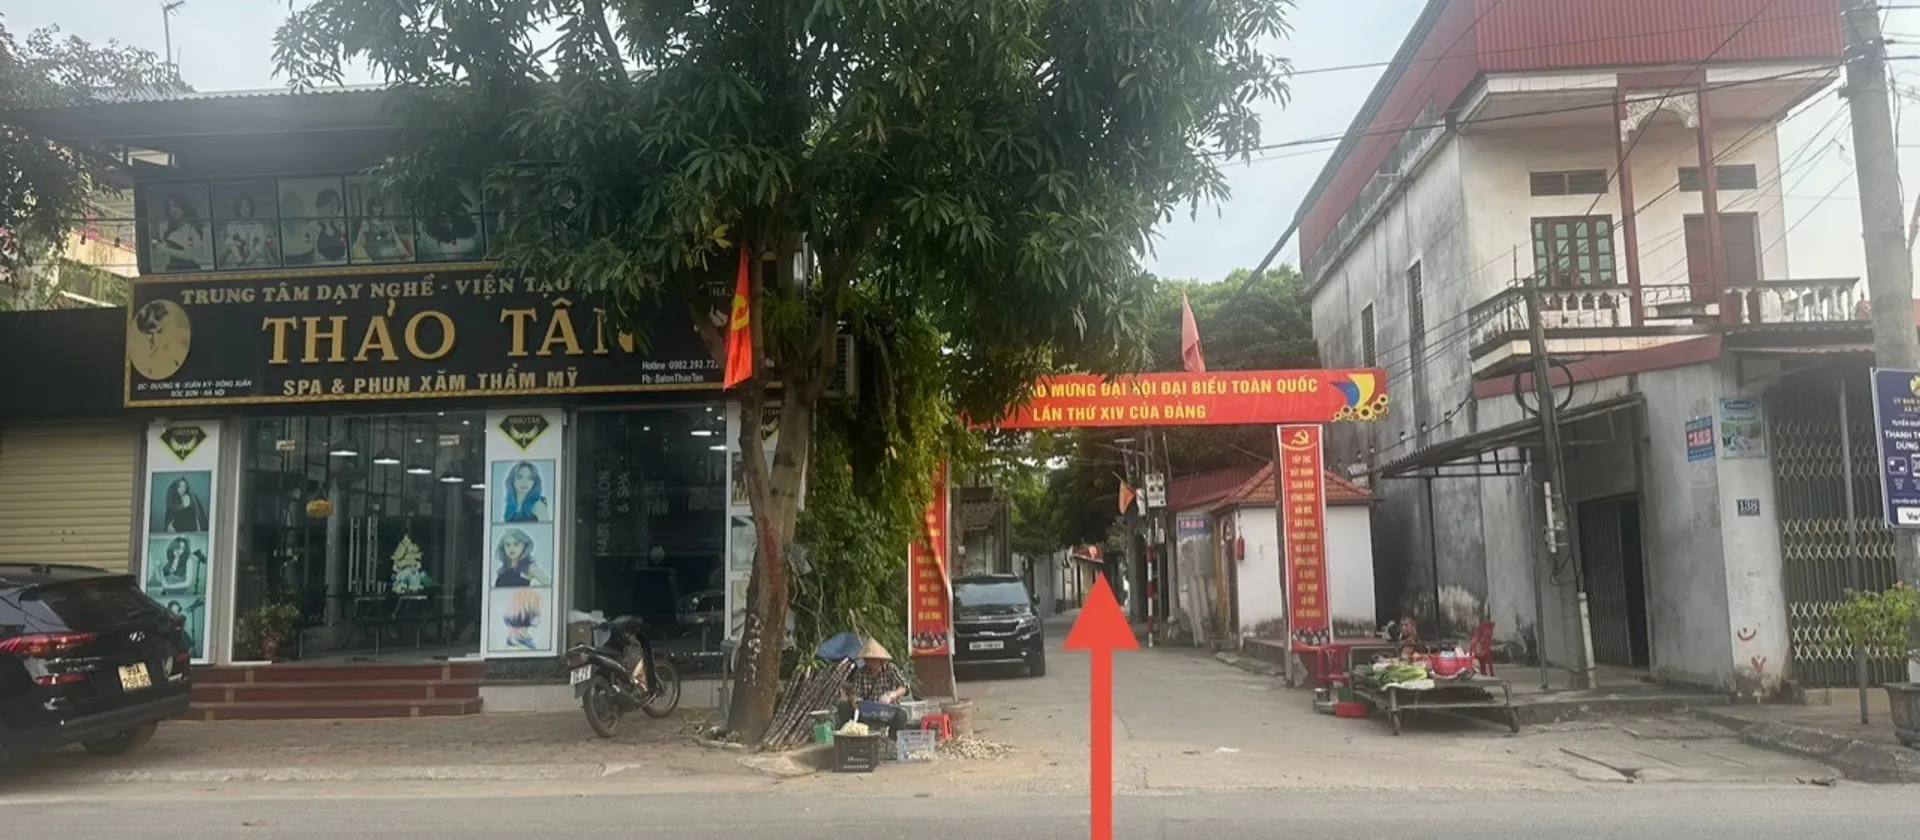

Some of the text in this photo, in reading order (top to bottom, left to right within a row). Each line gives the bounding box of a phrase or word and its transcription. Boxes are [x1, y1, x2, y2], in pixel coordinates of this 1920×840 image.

[181, 287, 256, 304] TRUNG
[262, 281, 310, 302] TÂM
[316, 283, 363, 305] DẠY
[369, 273, 435, 298] NGHỀ
[454, 273, 515, 300] VIỆN
[261, 298, 456, 364] THẢO
[283, 362, 579, 396] SPA & PHUN XĂM THẨM MỸ
[1052, 380, 1096, 397] MỪNG
[1101, 381, 1126, 399] ĐẠI
[1132, 379, 1157, 398] HỘI
[1161, 380, 1187, 398] ĐẠI
[1192, 375, 1227, 394] BIỂU
[1232, 377, 1271, 394] TOÀN
[1277, 374, 1318, 393] QUỐC
[1033, 401, 1206, 422] LẦN THỨ XIV CỦA ĐẢNG
[1739, 501, 1758, 511] 138
